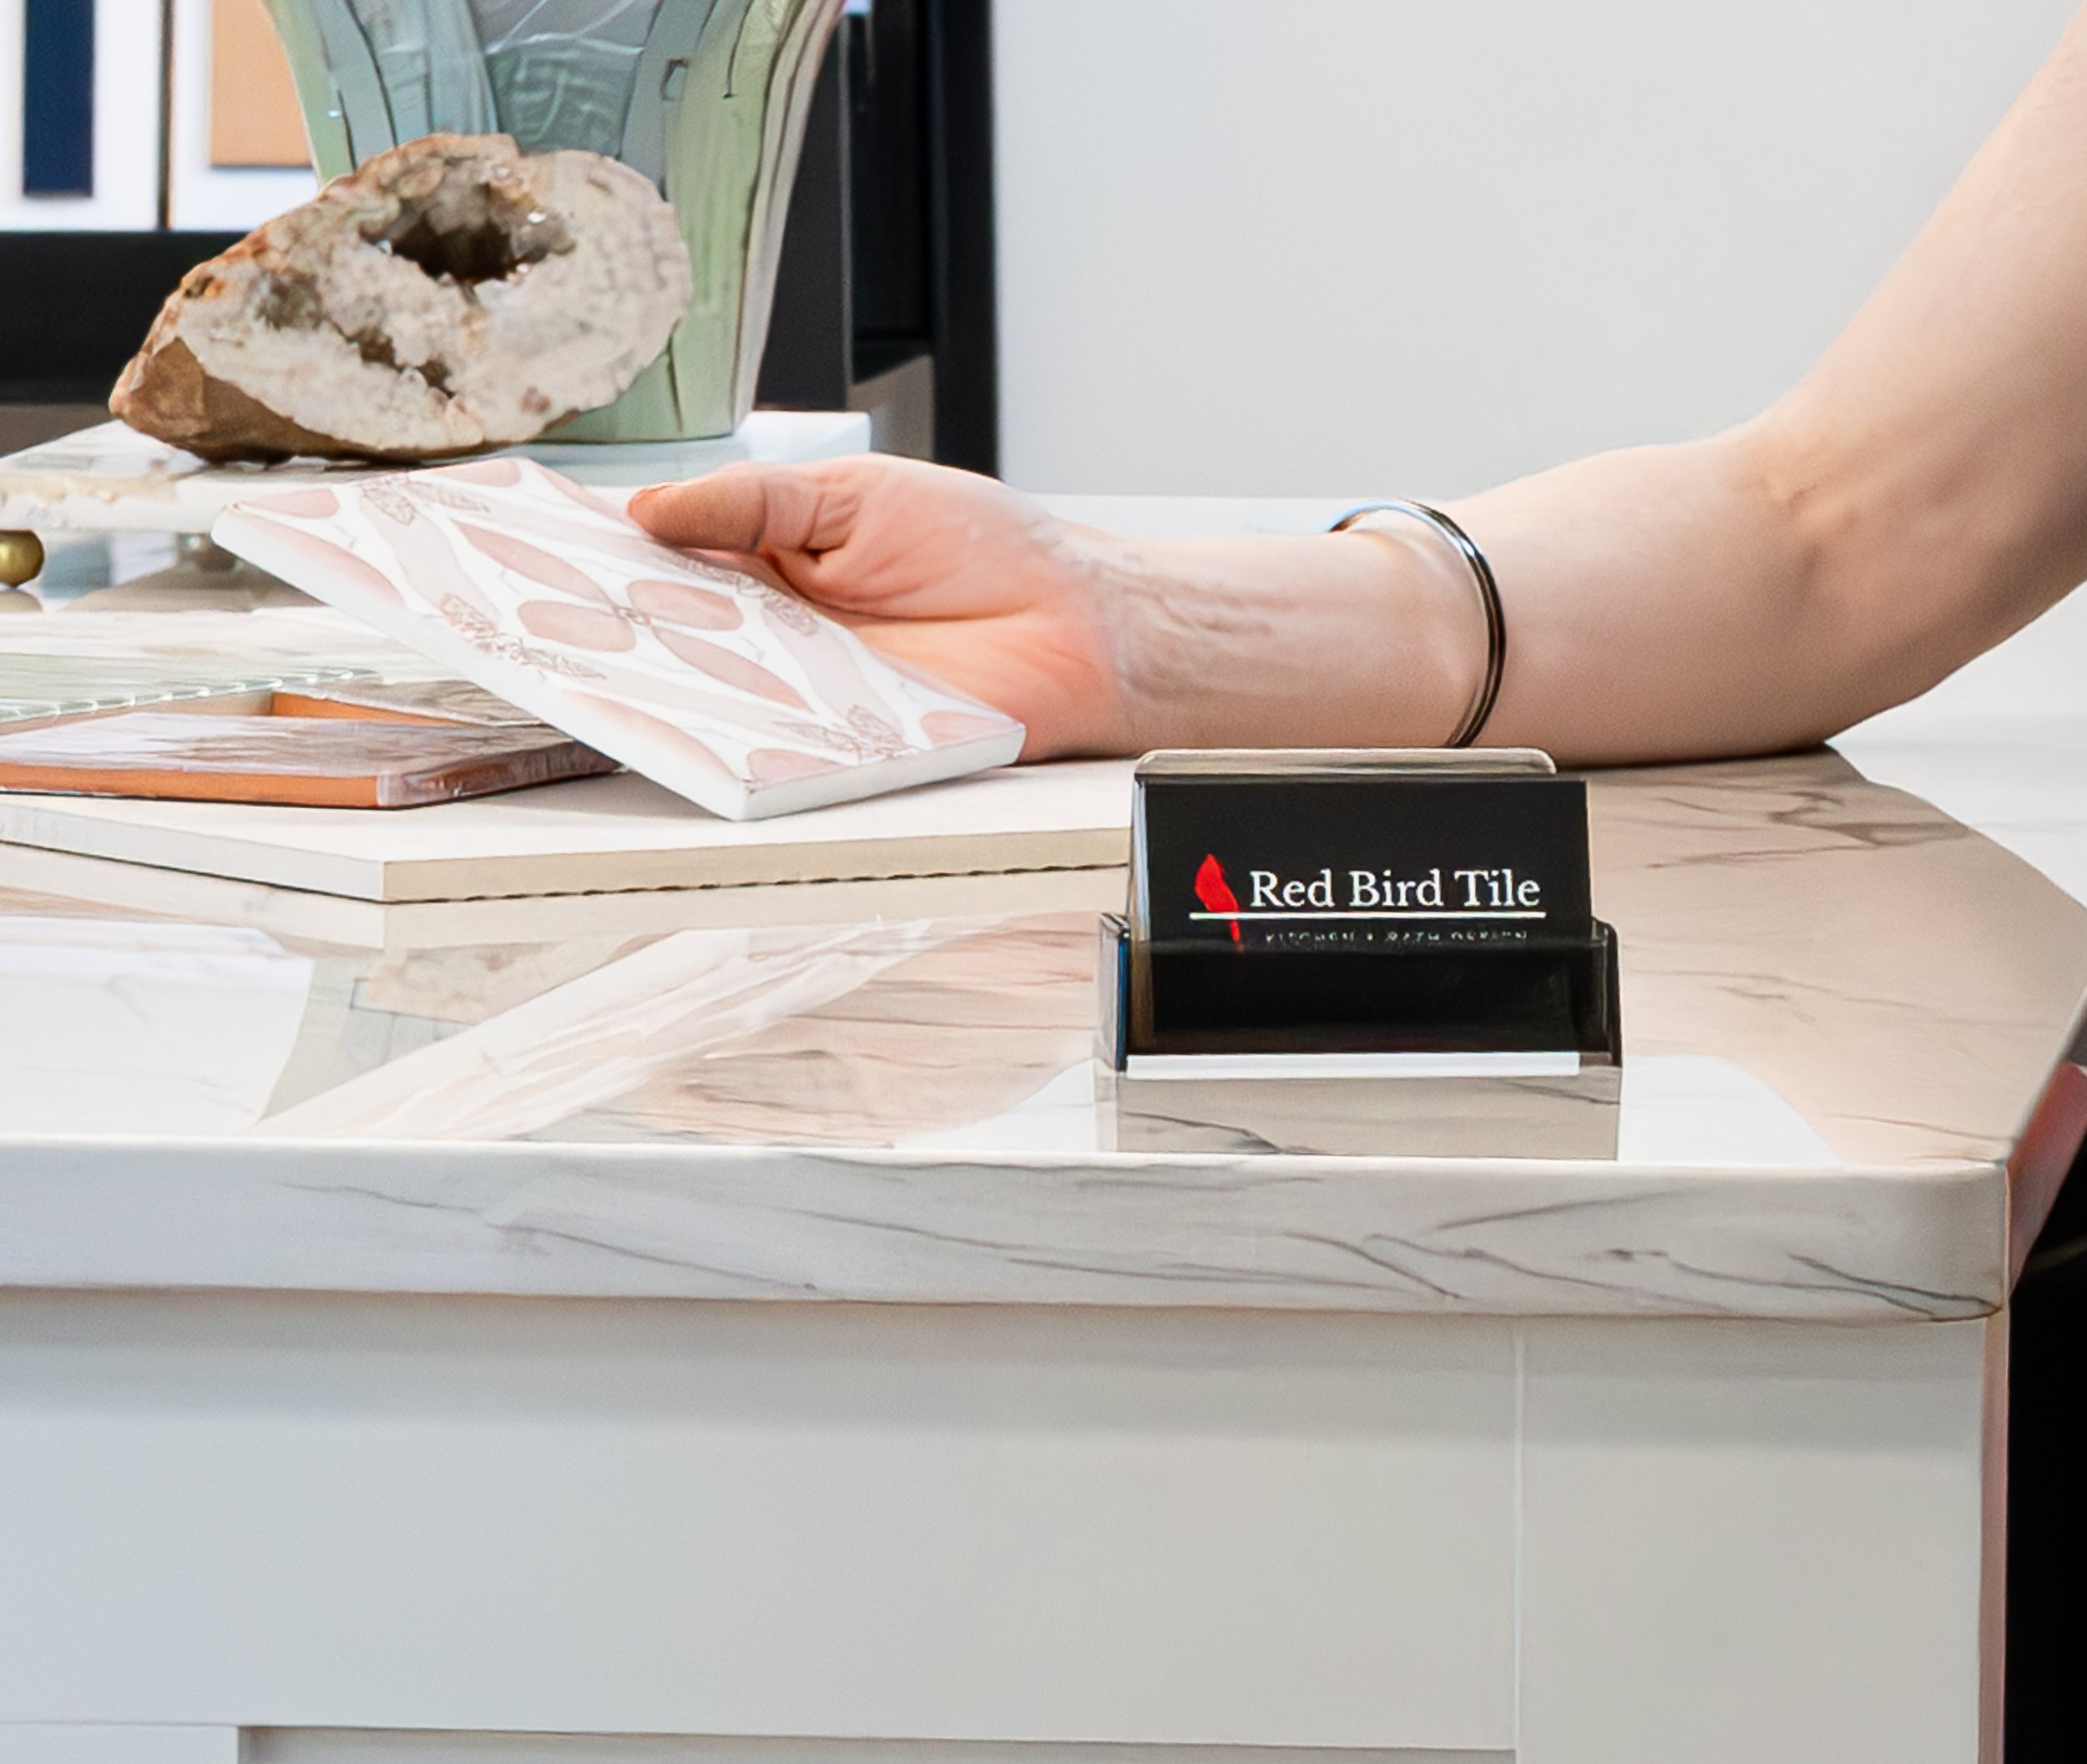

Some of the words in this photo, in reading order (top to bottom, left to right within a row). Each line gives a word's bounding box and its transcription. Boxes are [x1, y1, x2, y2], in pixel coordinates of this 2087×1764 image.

[1250, 868, 1336, 907] Red
[1349, 868, 1443, 907] Bird
[1454, 868, 1541, 907] Tile
